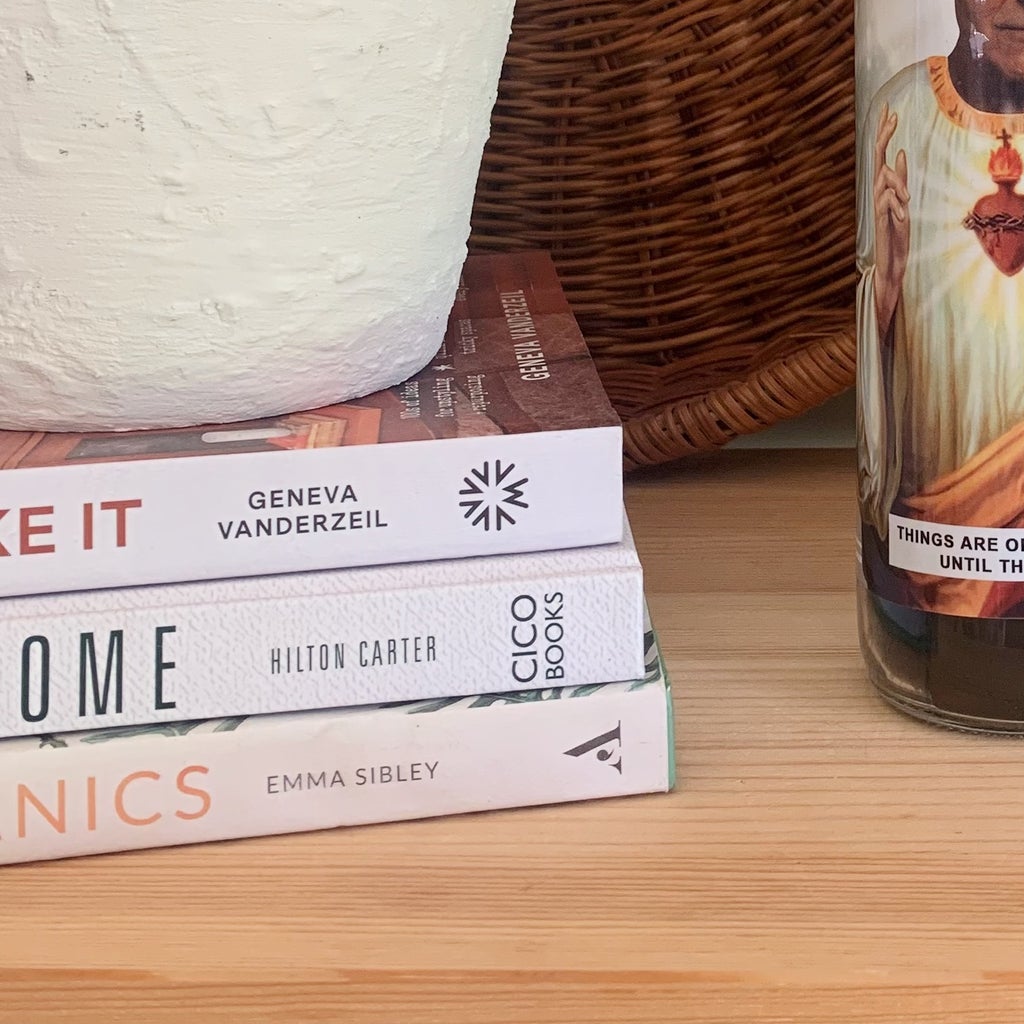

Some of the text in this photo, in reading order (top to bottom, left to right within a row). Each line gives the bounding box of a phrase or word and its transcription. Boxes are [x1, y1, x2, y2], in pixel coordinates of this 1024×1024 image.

[500, 289, 551, 382] GENEVA VANDERZEIL
[248, 484, 358, 510] GENEVA
[0, 499, 142, 557] E IT
[217, 509, 388, 540] VANDERZEIL
[897, 525, 955, 549] THINGS
[960, 536, 999, 552] ARE
[940, 554, 992, 573] UNTIL
[271, 636, 437, 675] HILTON CARTER
[511, 594, 538, 683] CICO
[544, 591, 565, 680] BOOKS
[20, 625, 177, 723] OME
[17, 765, 211, 839] NICS
[267, 761, 439, 795] EMMA SIBLEY
